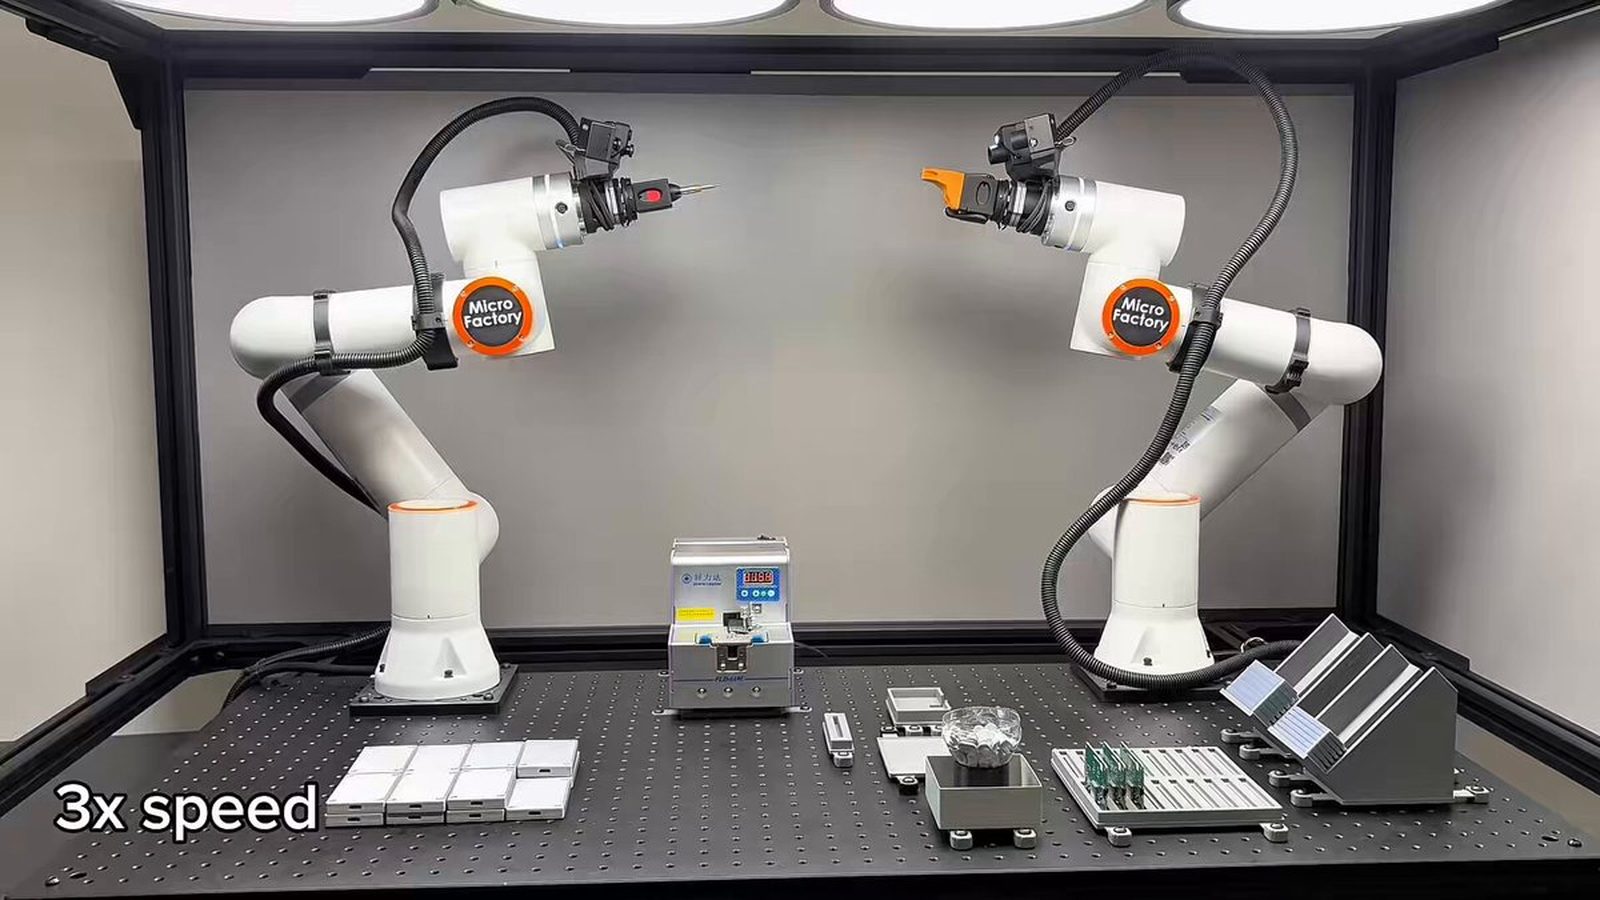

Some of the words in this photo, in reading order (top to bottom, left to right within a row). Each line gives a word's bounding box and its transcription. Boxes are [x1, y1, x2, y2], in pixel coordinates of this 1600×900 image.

[469, 299, 513, 315] Micro
[1121, 297, 1164, 316] Micro
[463, 312, 522, 329] Factory
[1113, 308, 1169, 333] Factory
